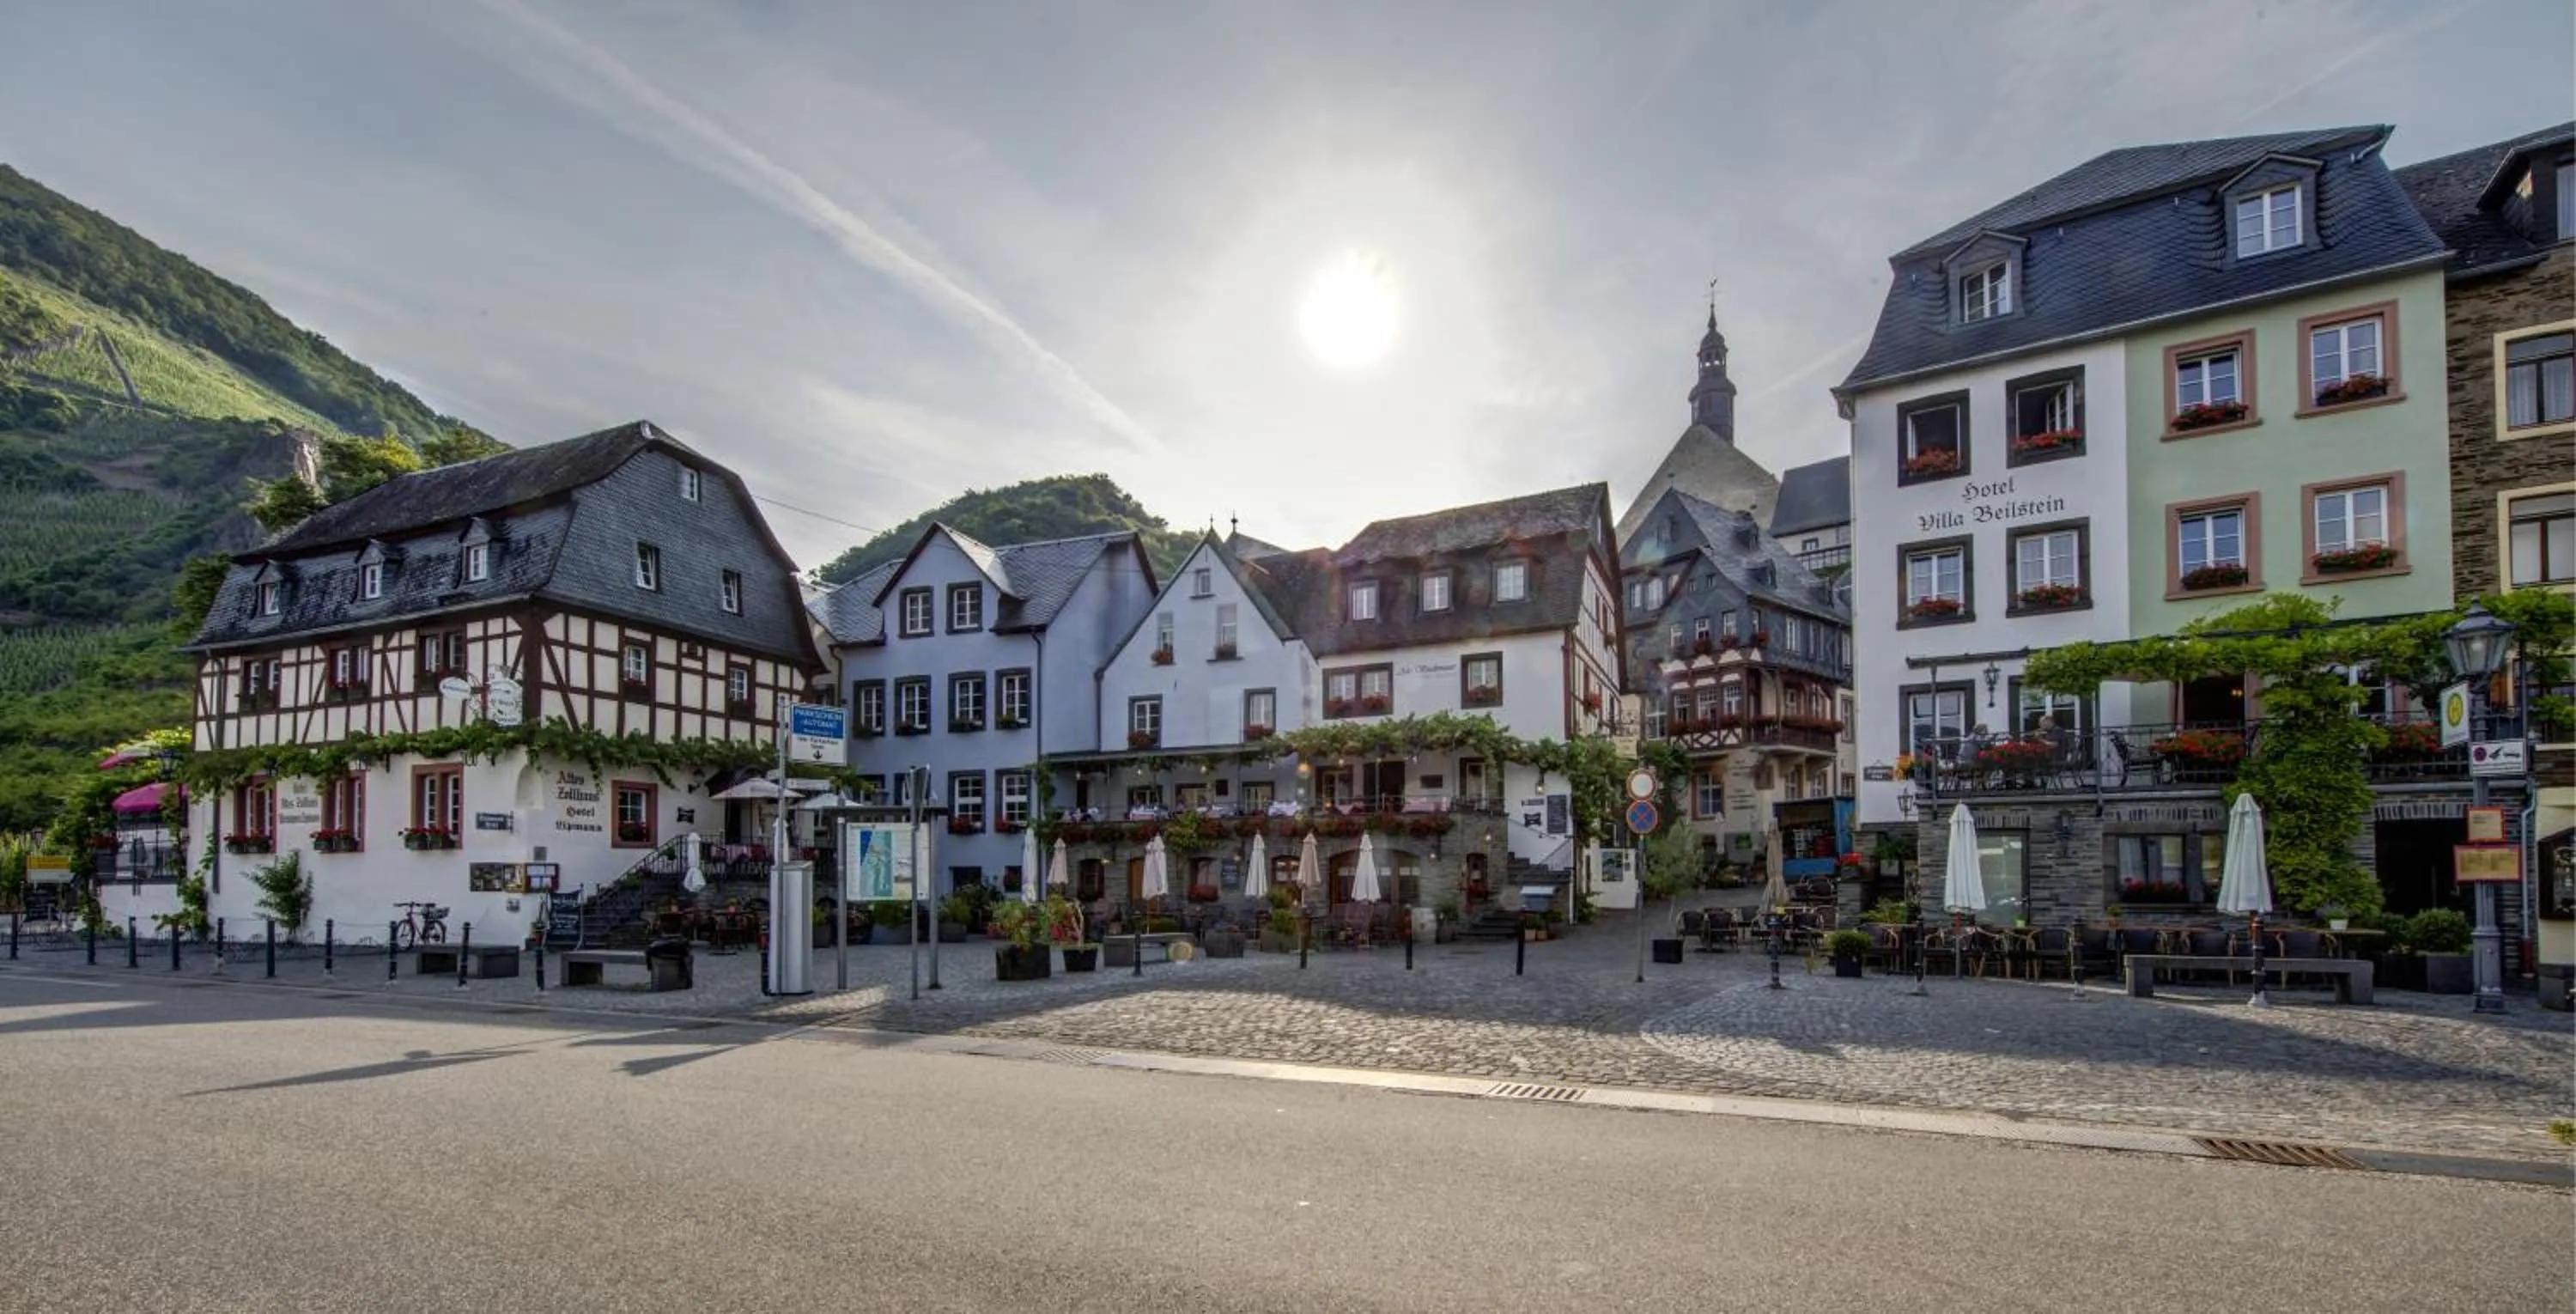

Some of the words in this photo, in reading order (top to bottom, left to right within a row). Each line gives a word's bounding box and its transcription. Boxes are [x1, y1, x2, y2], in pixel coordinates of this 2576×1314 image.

[1962, 476, 2014, 503] Hotel
[1918, 512, 1964, 531] Villa
[1973, 495, 2064, 523] Beilstein
[794, 709, 842, 721] PARKSCHEIN
[566, 806, 595, 818] Hotel
